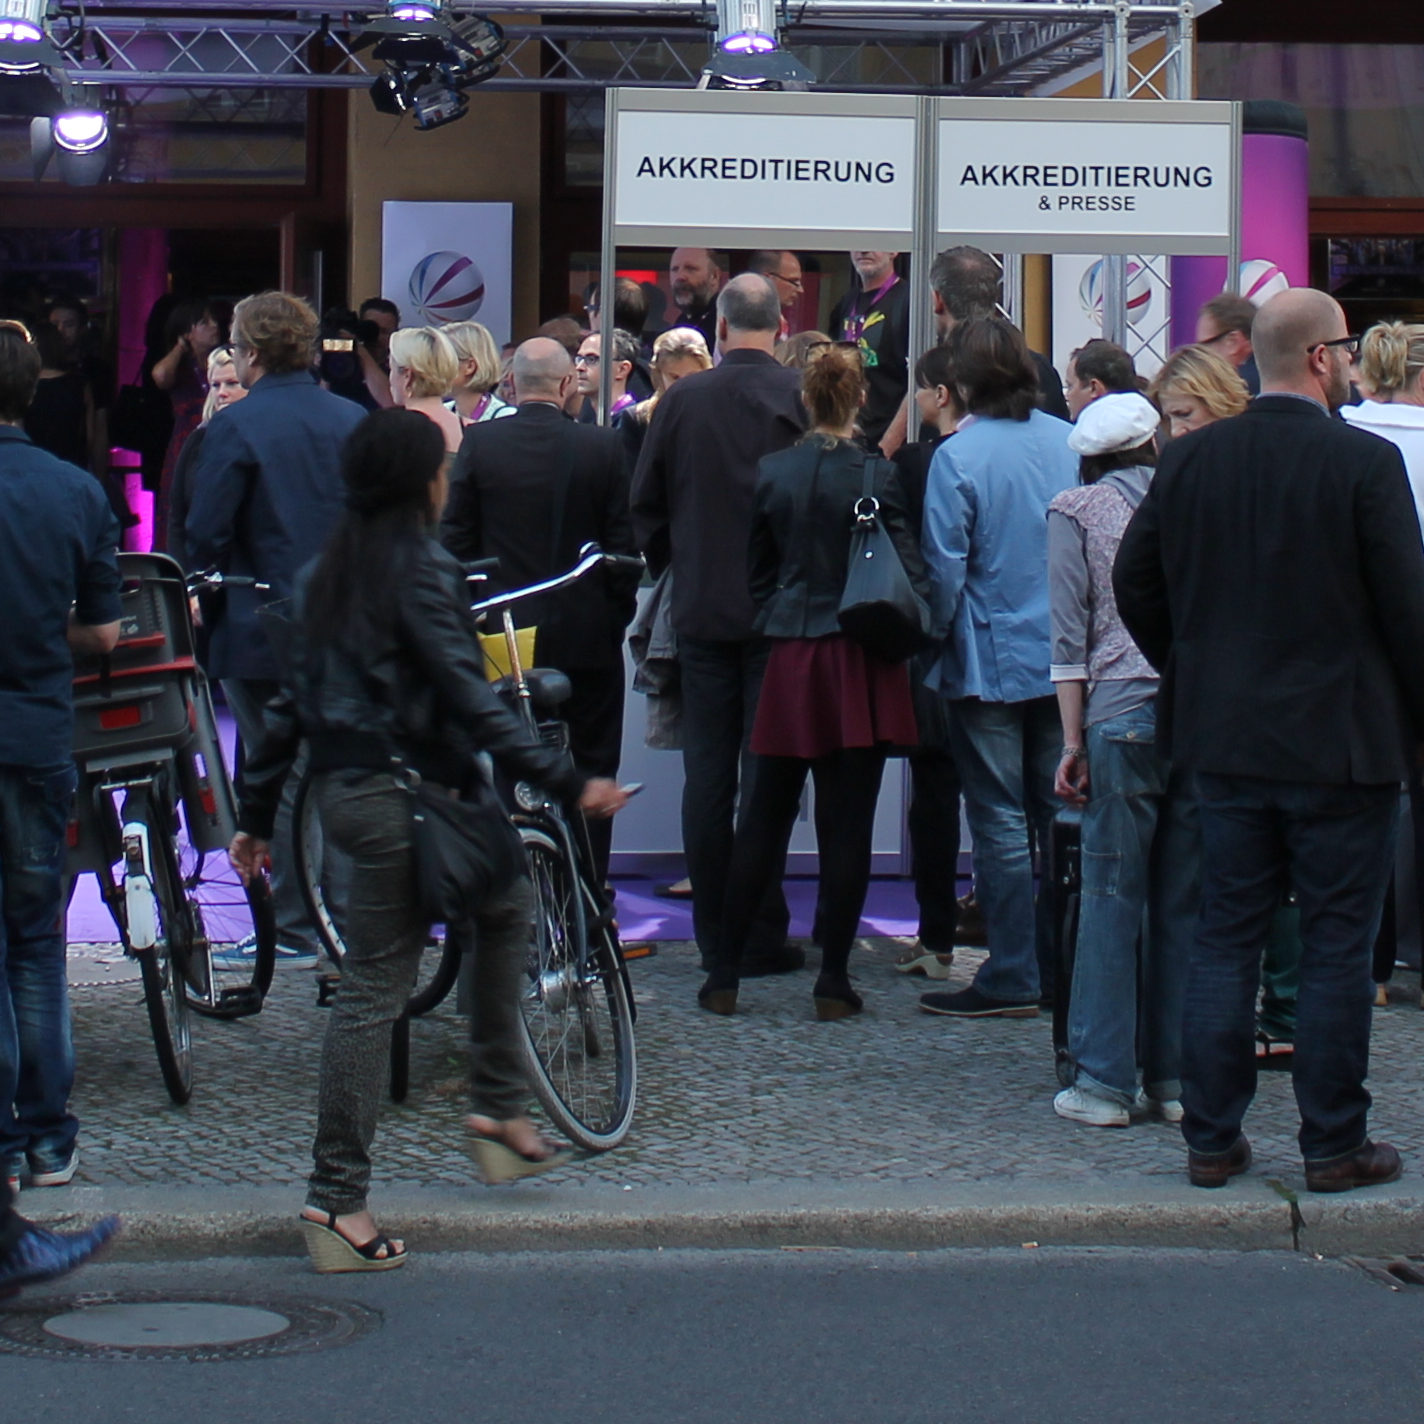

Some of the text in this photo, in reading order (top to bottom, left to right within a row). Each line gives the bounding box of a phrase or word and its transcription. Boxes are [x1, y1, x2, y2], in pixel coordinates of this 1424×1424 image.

[635, 155, 896, 185] AKKREDITIERUNG
[959, 164, 1214, 190] AKKREDITIERUNG
[1037, 195, 1136, 213] & PRESSE
